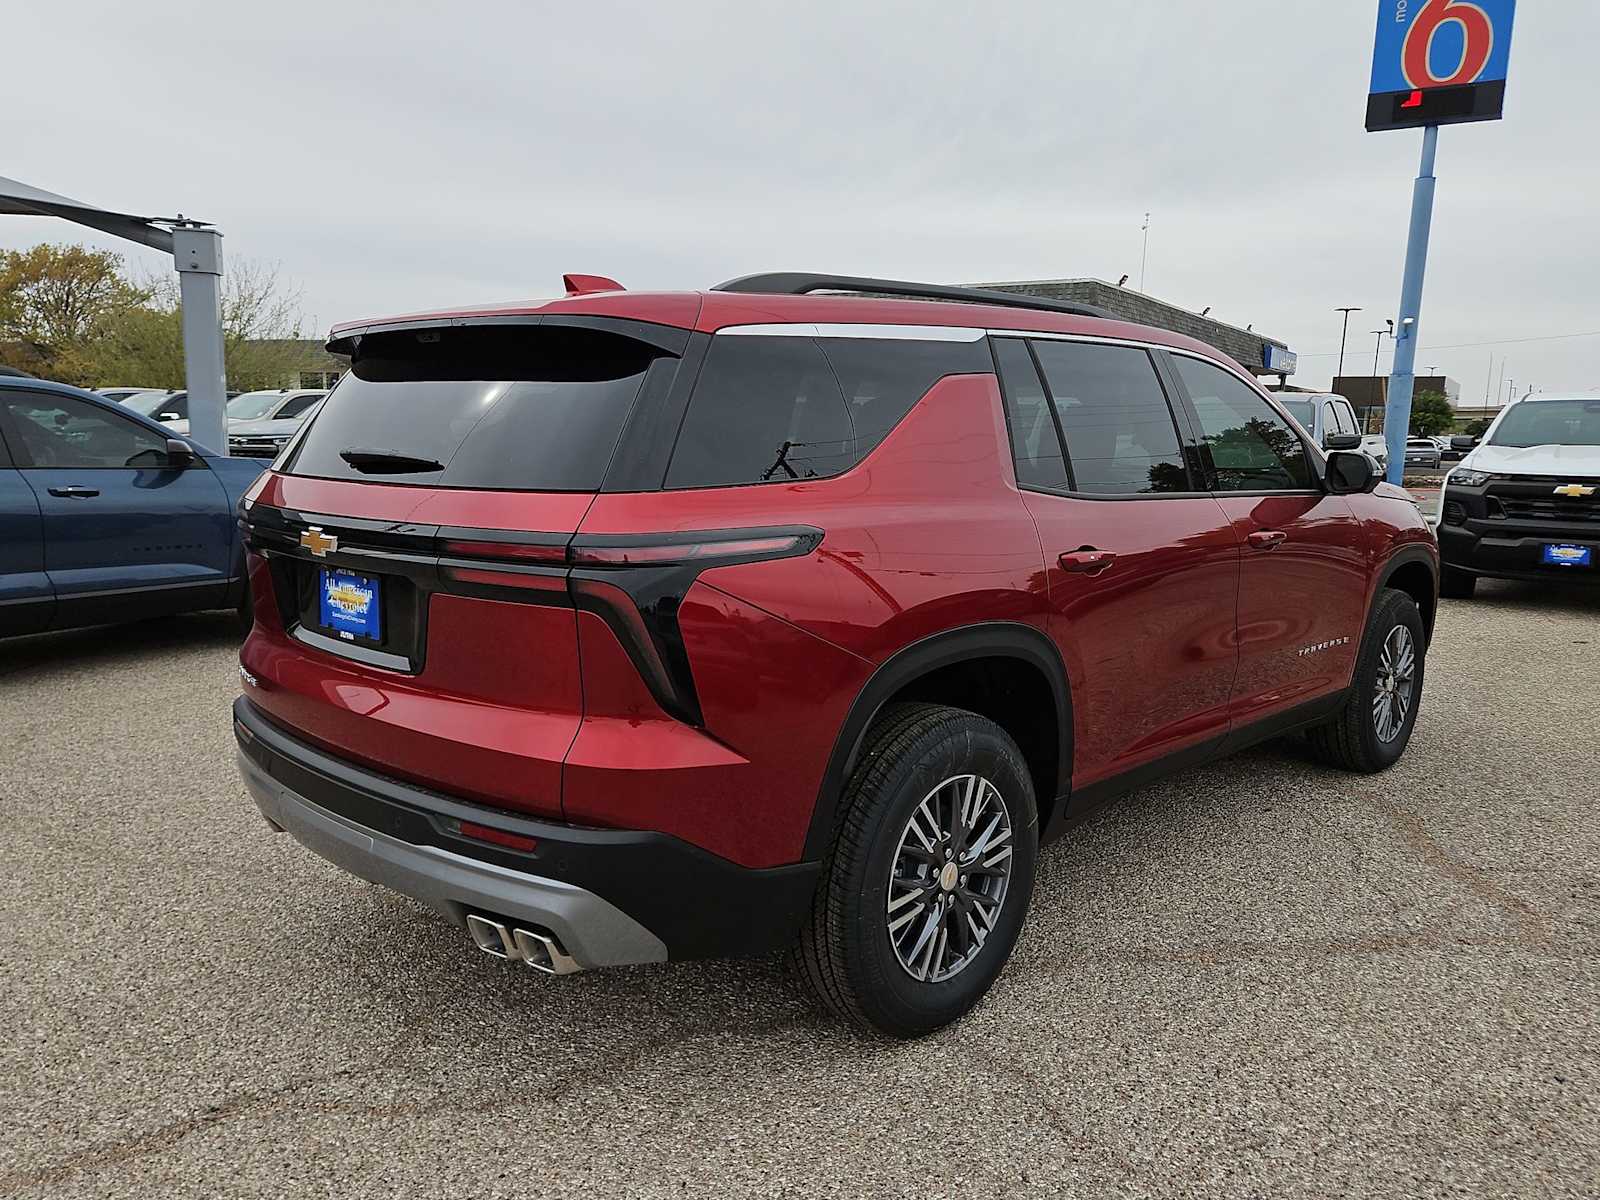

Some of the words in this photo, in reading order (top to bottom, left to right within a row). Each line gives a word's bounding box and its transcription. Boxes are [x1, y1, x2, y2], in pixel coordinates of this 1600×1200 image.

[1401, 0, 1494, 89] 6
[325, 578, 336, 591] All
[1298, 636, 1350, 657] TRAVERSE
